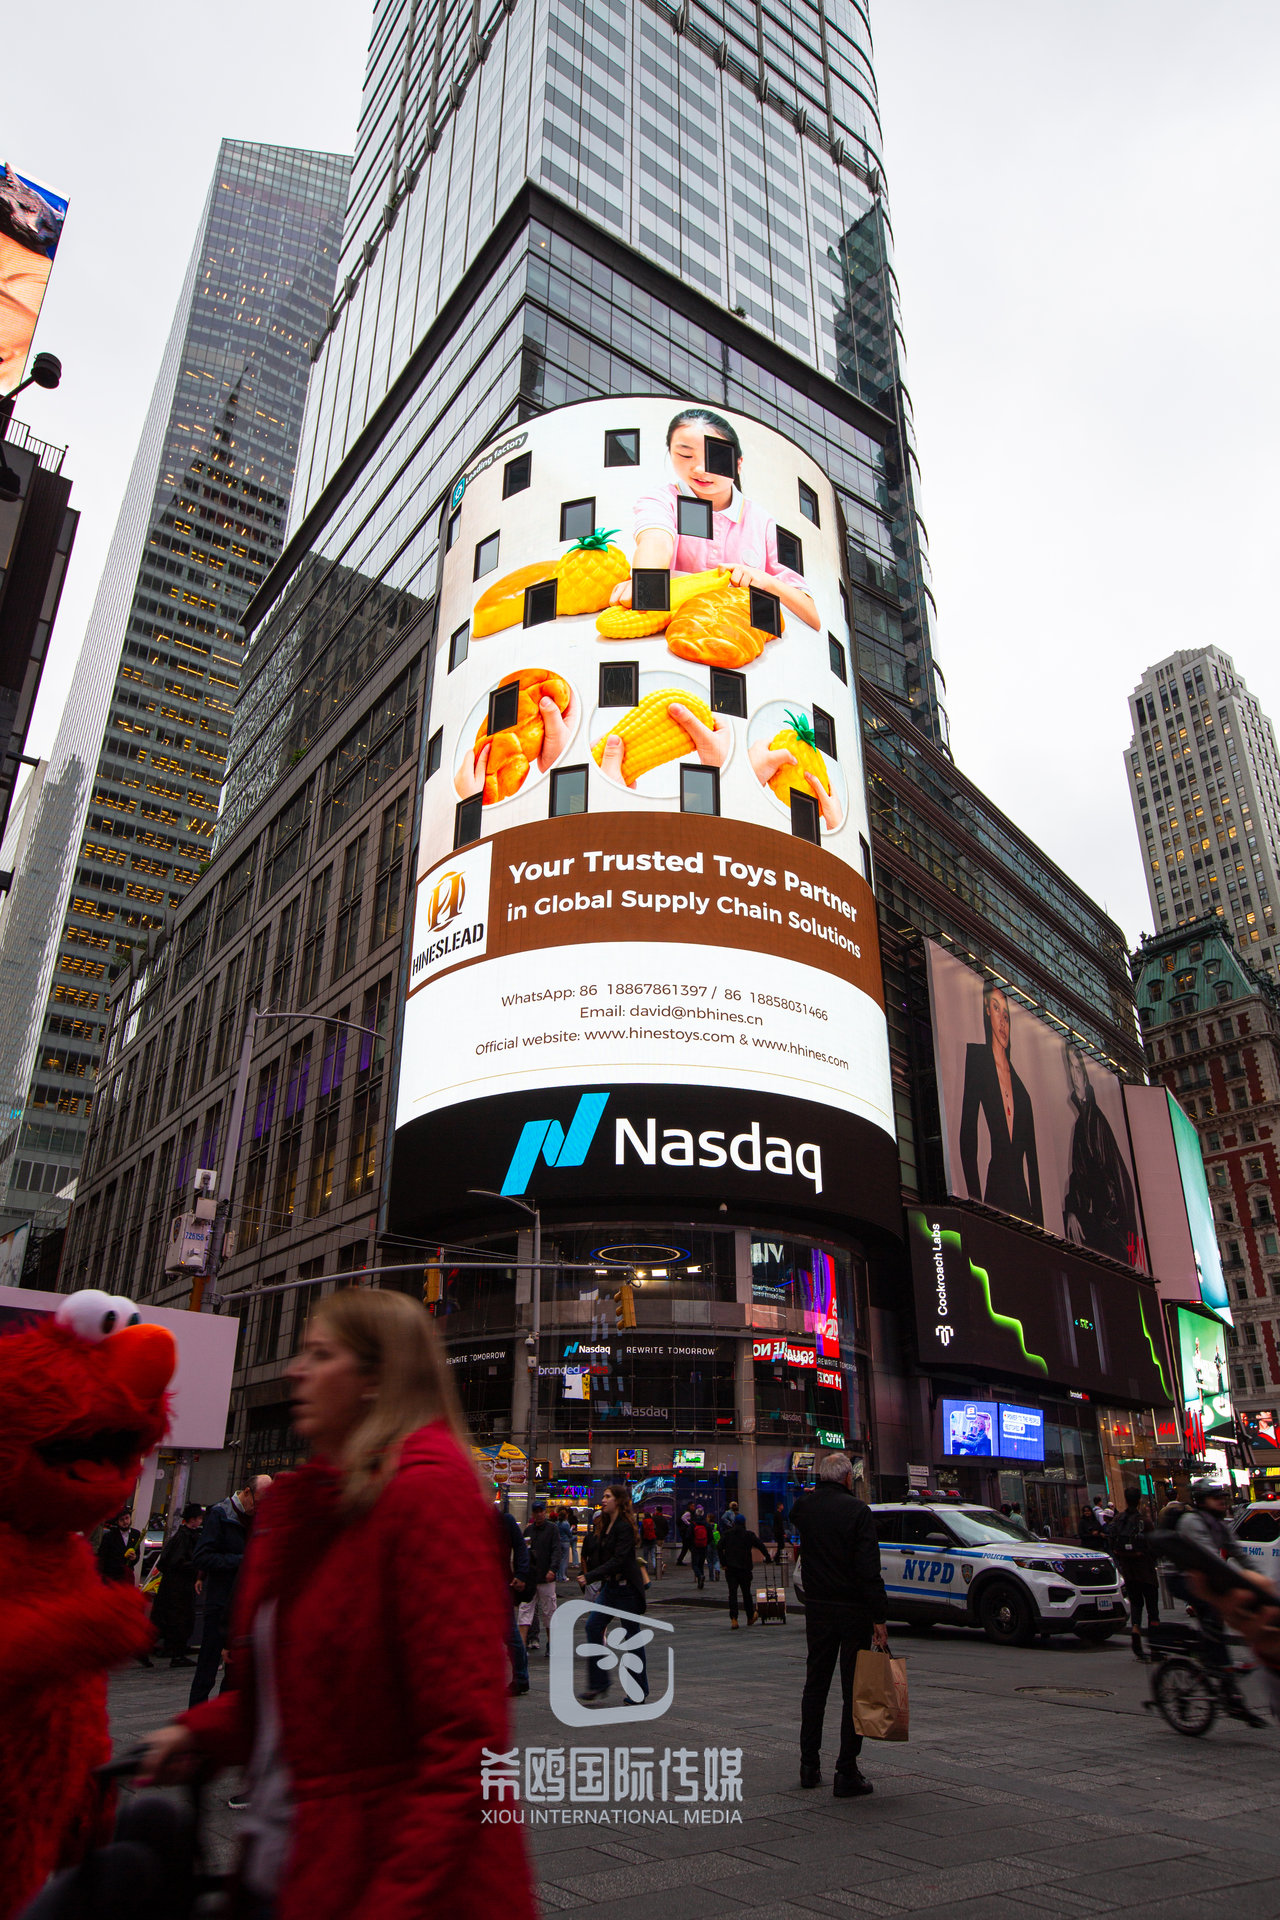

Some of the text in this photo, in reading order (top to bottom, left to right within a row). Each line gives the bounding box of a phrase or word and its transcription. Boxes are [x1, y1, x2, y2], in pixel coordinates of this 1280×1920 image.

[465, 436, 525, 485] Leading factory
[508, 850, 858, 924] Your Trusted Toys Partner
[507, 889, 861, 959] in Global Supply Chain Solutions
[412, 923, 484, 977] HINESLEAD
[501, 983, 828, 1022] WhatsApp: 86 18867861397 / 86 18858031466
[580, 1004, 763, 1026] Email: david@nbhines.cn
[475, 1026, 849, 1070] Official website: www.hinestoys.com & www.hhines.com
[615, 1118, 823, 1195] Nasdaq
[931, 1223, 948, 1316] Cockroach Labs
[446, 1351, 506, 1364] REWRITE TOMORROW
[578, 1345, 611, 1355] Nasdaq
[626, 1346, 715, 1355] REWRITE TOMORROW
[623, 1406, 668, 1419] Nasdaq
[902, 1558, 955, 1585] NYPD
[982, 1552, 1005, 1561] POLICE
